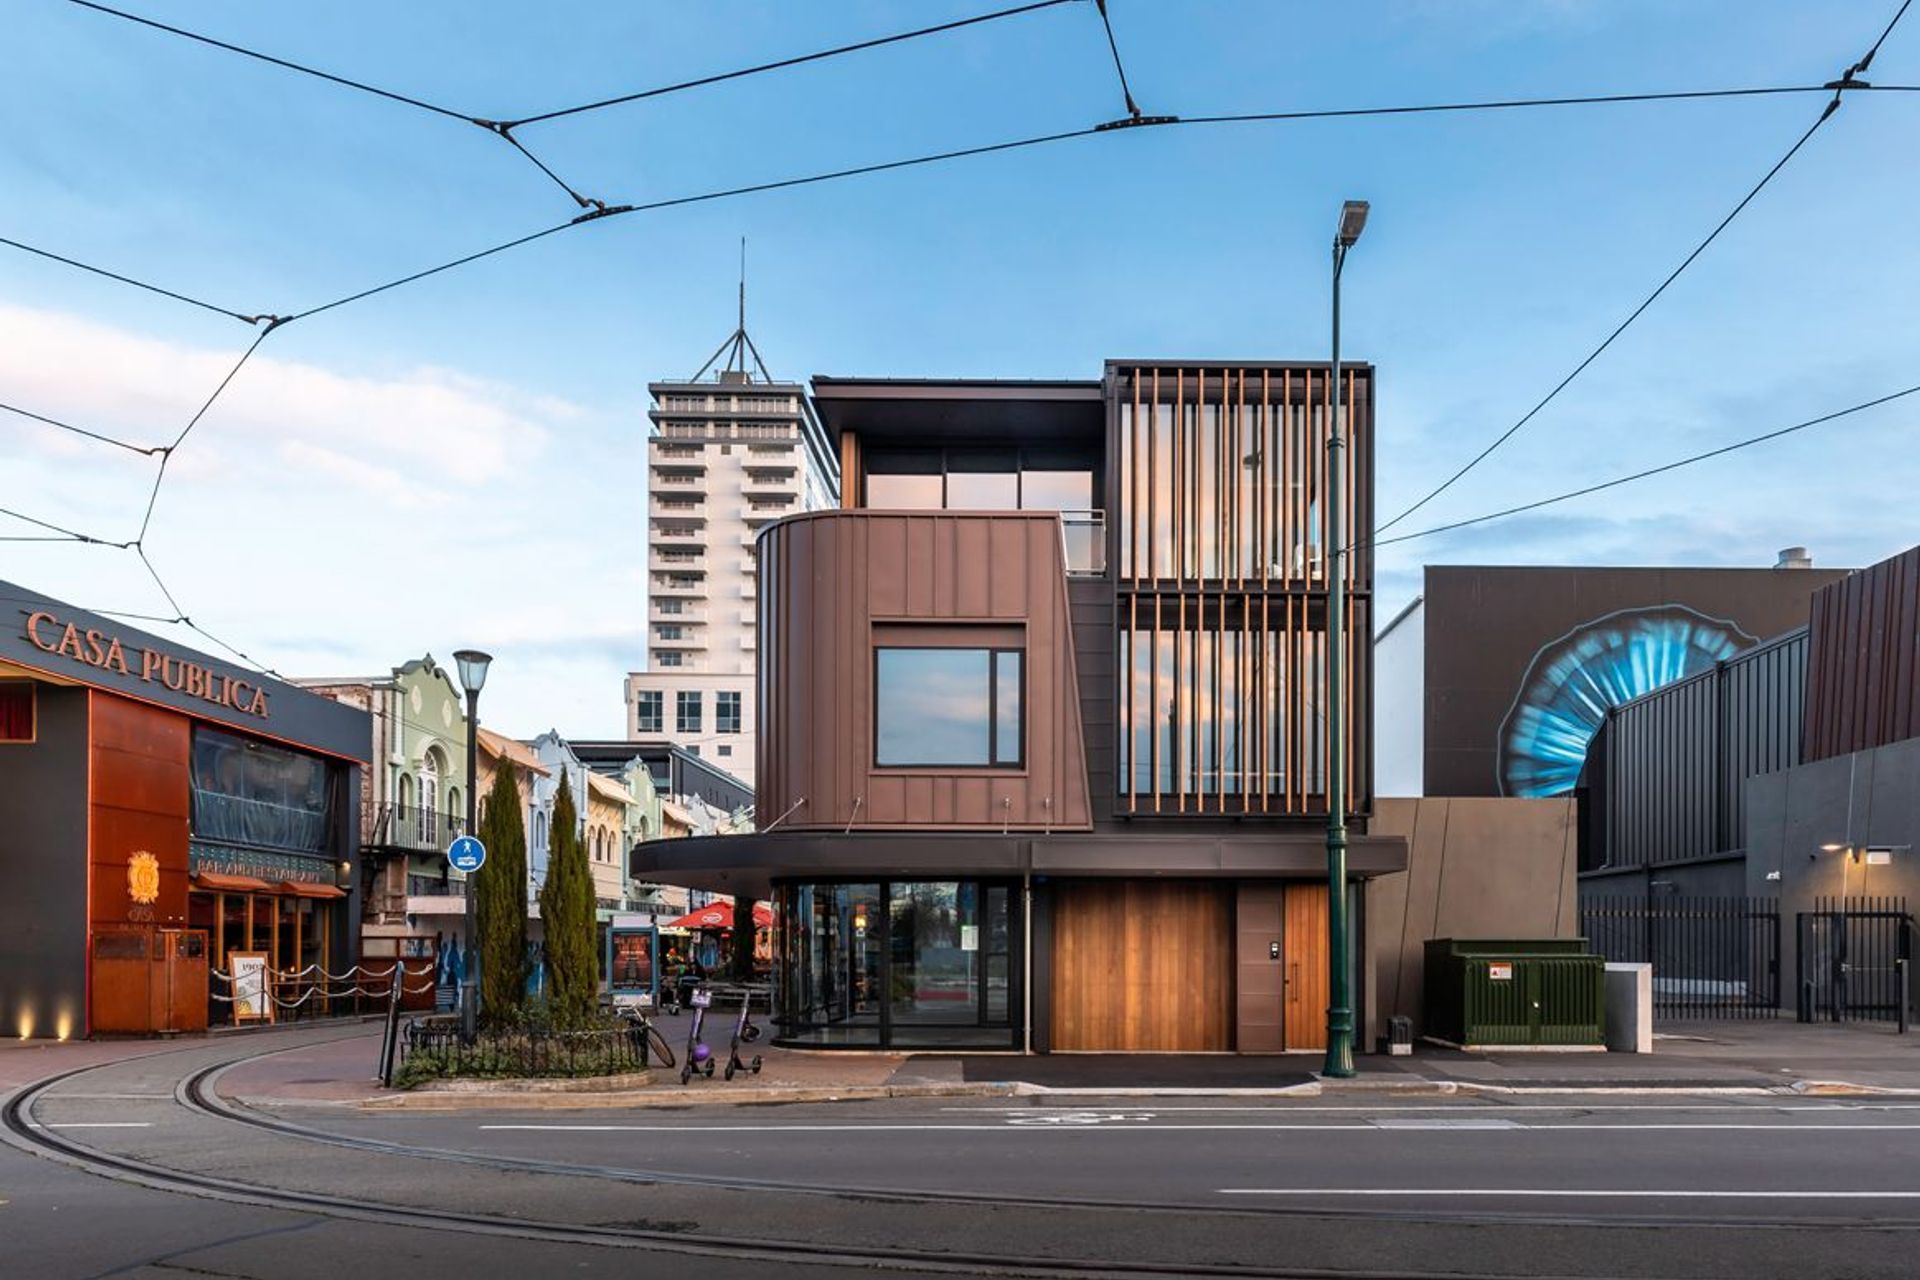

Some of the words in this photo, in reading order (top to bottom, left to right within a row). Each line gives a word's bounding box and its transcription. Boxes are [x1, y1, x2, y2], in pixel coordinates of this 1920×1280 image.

[27, 610, 129, 675] CASA
[141, 646, 270, 719] PUBLICA
[197, 859, 221, 873] BAR
